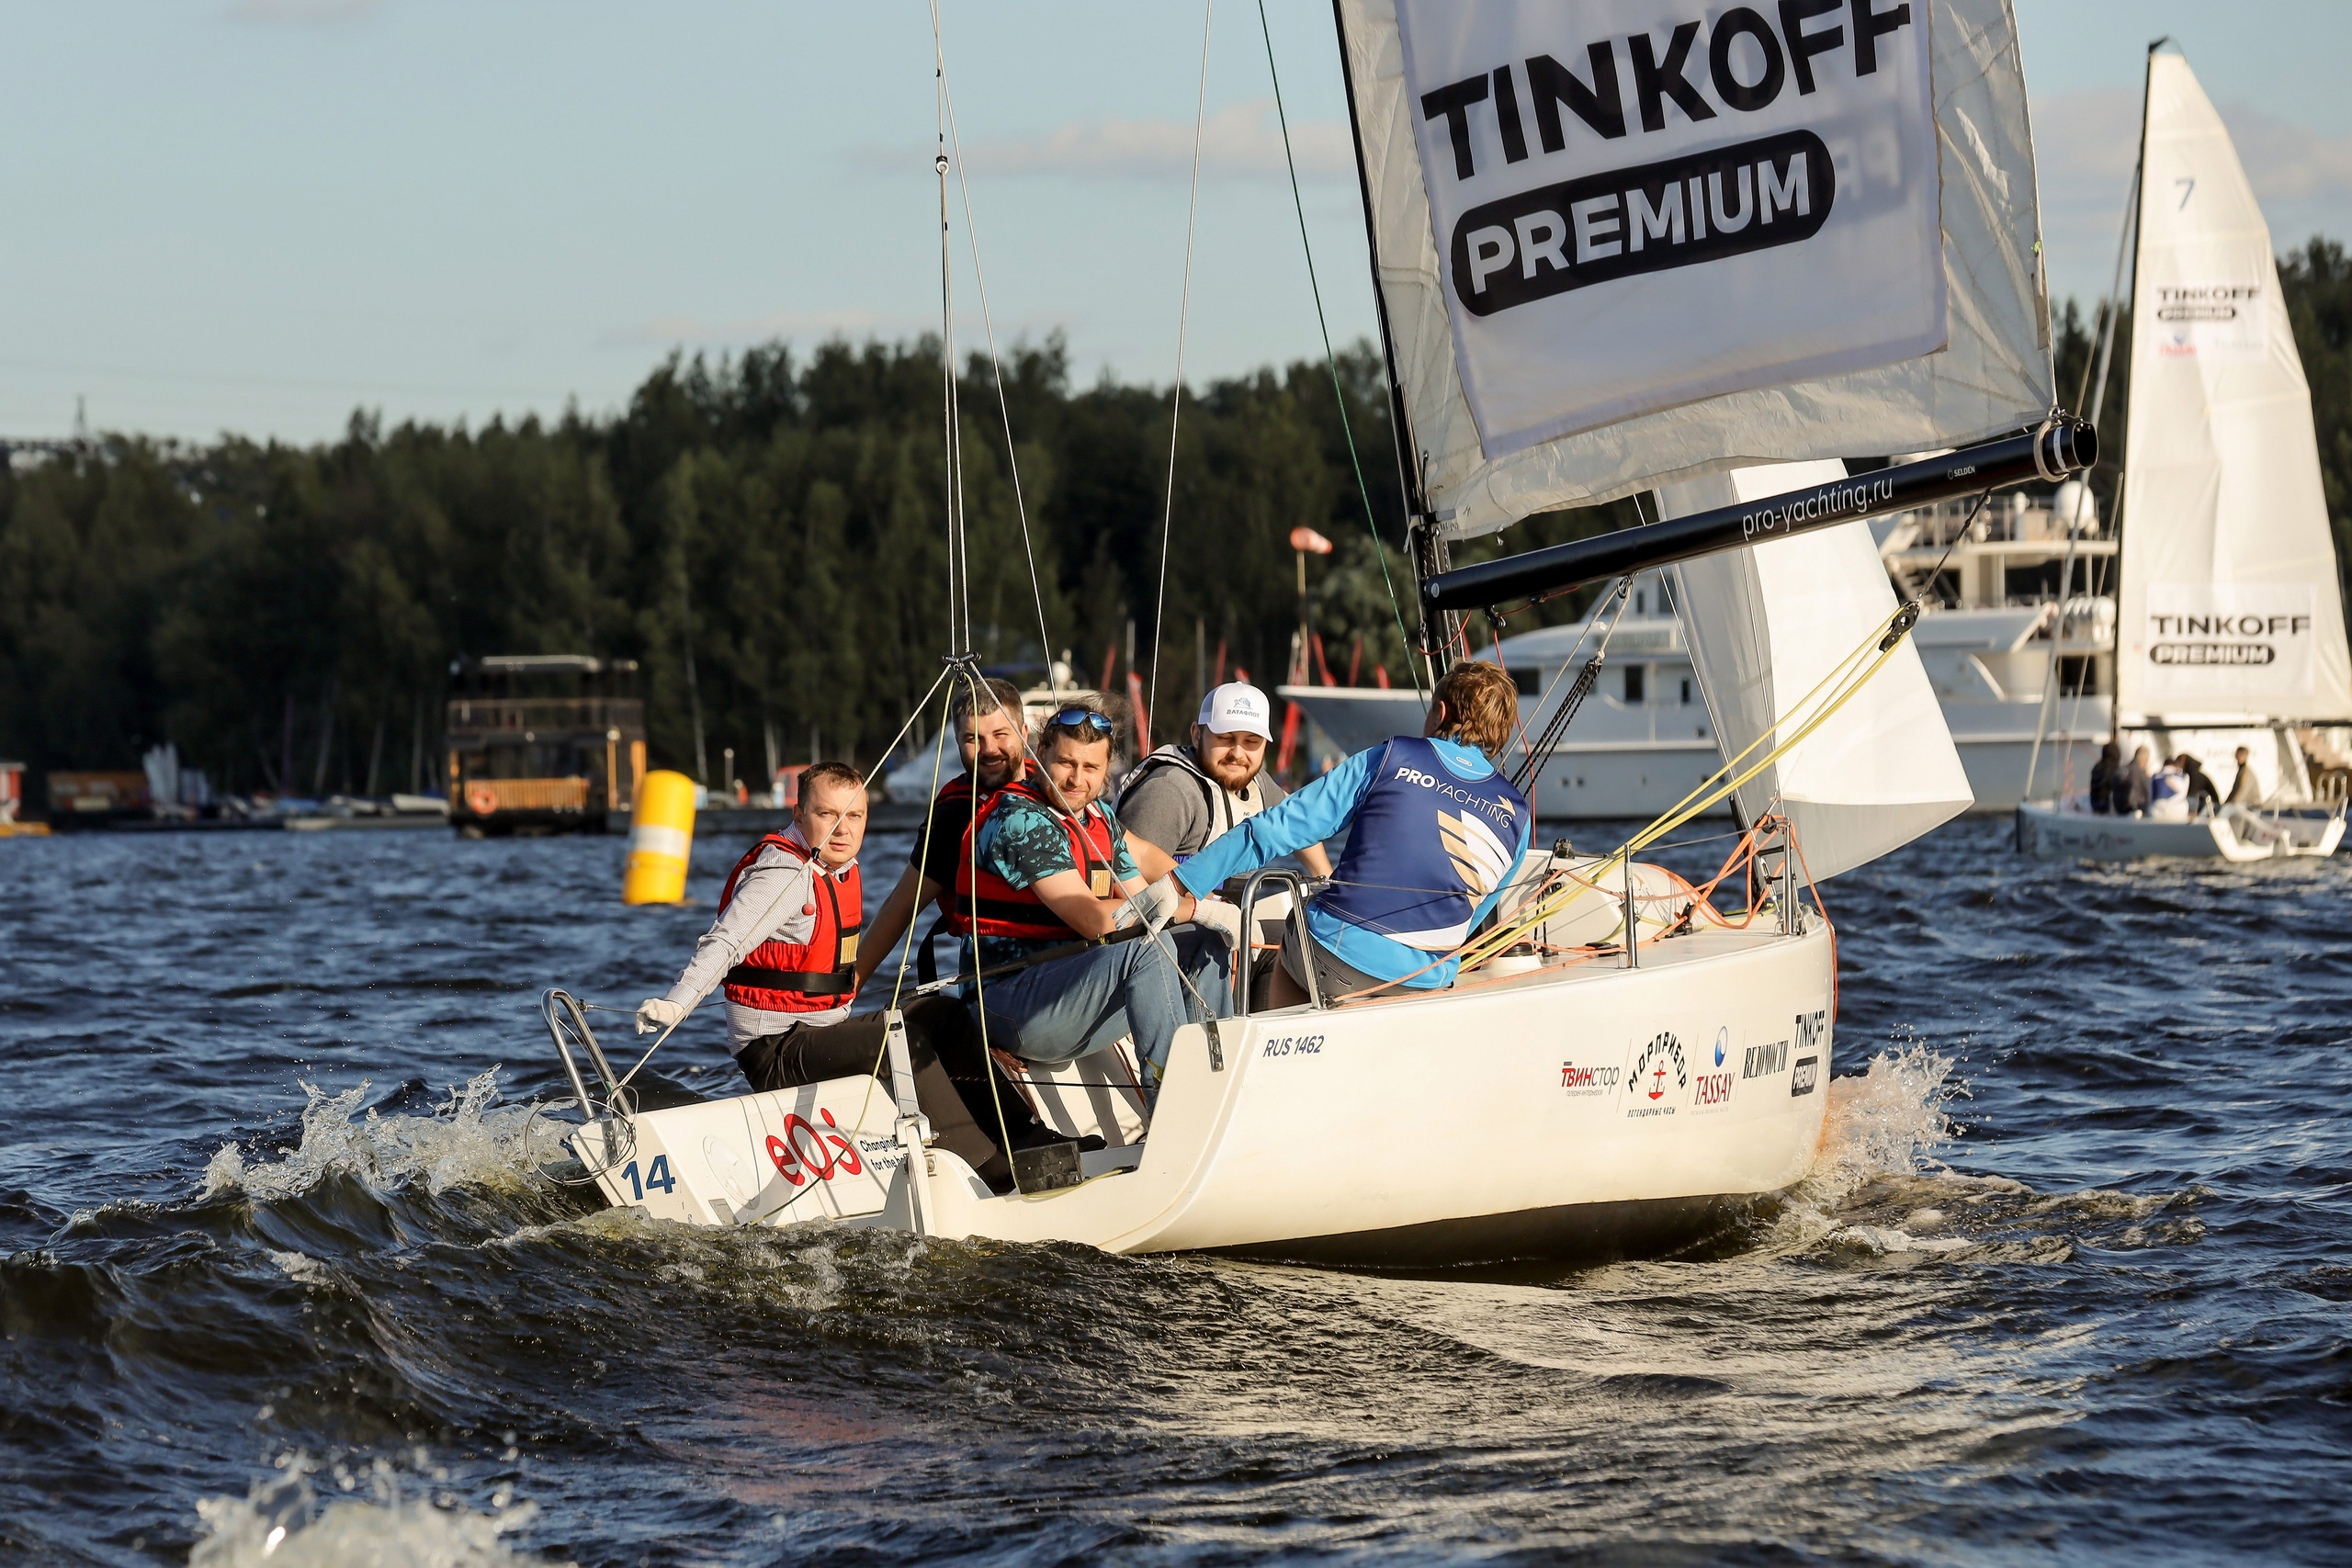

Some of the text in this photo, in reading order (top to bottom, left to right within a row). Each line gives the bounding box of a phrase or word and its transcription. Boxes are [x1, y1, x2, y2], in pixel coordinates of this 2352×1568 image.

[1420, 0, 1911, 181] TINKOFF
[2176, 178, 2196, 211] 7
[1465, 151, 1811, 294] PREMIUM
[2157, 286, 2261, 301] TINKOFF
[1742, 478, 1894, 541] pro-yachting.ru
[2151, 615, 2310, 635] TINKOFF
[2155, 645, 2268, 664] PREMIUM
[1227, 709, 1260, 718] ДАТАФЛОТ
[1395, 767, 1513, 828] PROYACHTING
[1263, 1035, 1324, 1057] RUS 1462
[1795, 1010, 1825, 1049] TINKOFF
[1628, 1032, 1687, 1093] МОРПРИБОР
[1743, 1040, 1789, 1079] ВЕДОМОСТИ
[1695, 1072, 1736, 1105] TASSAY
[860, 1136, 898, 1152] Changing
[621, 1155, 675, 1201] 14
[871, 1158, 884, 1171] for
[883, 1156, 898, 1169] the
